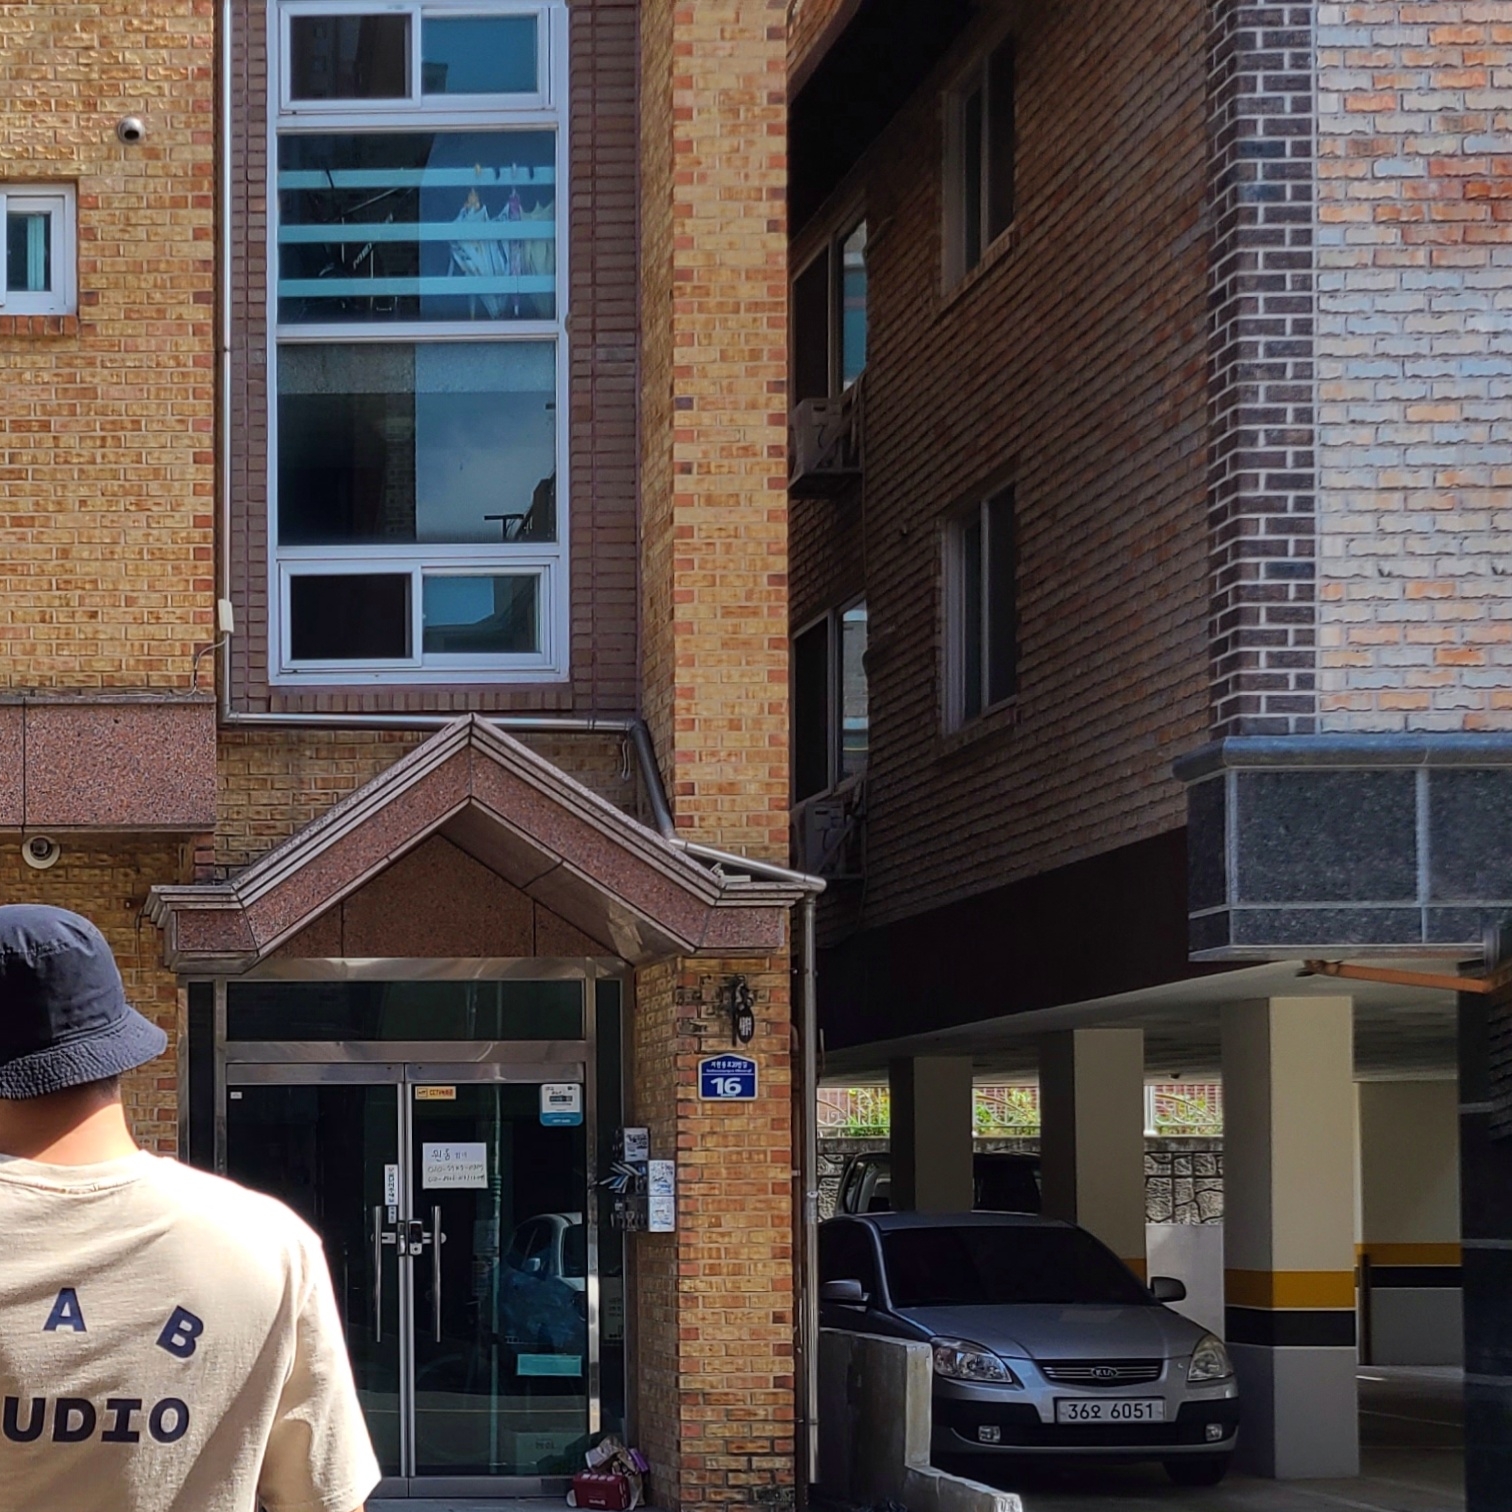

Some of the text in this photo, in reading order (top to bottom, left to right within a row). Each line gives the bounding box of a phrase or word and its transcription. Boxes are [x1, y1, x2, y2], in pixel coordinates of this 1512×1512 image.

[710, 1077, 742, 1095] 16
[1067, 1403, 1153, 1420] 36오 6051
